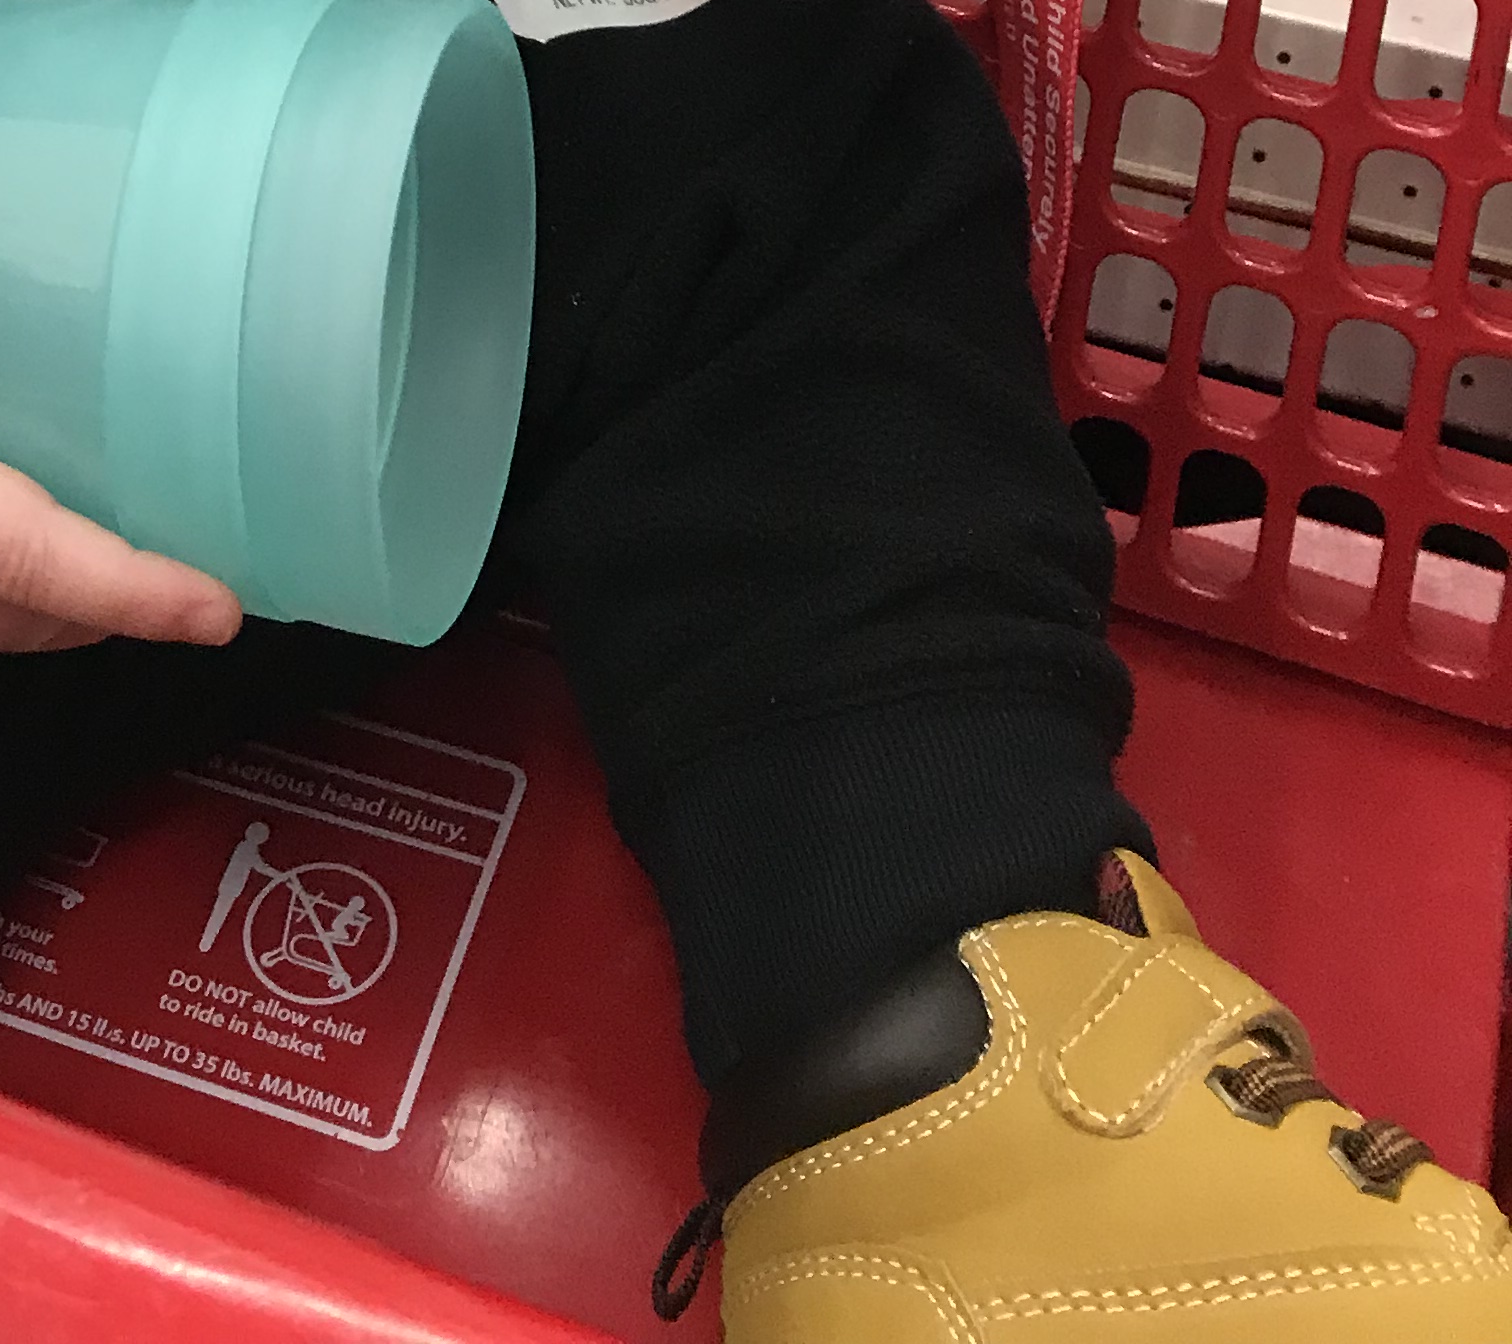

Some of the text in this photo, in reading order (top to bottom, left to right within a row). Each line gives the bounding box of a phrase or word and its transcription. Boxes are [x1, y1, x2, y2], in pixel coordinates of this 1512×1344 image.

[1031, 83, 1061, 255] Securely
[229, 763, 315, 797] serious
[321, 782, 385, 818] head
[389, 800, 468, 843] injury.
[1, 940, 58, 975] times.
[5, 920, 55, 946] your
[159, 993, 327, 1063] to ride in basket.
[168, 968, 367, 1046] DO NOT allow child
[16, 993, 64, 1021] AND
[67, 1010, 92, 1031] 15
[130, 1029, 161, 1053] UP
[163, 1039, 191, 1064] TO
[191, 1050, 220, 1074] 35
[221, 1059, 254, 1088] lbs.
[258, 1072, 373, 1128] MAXIMUM.
